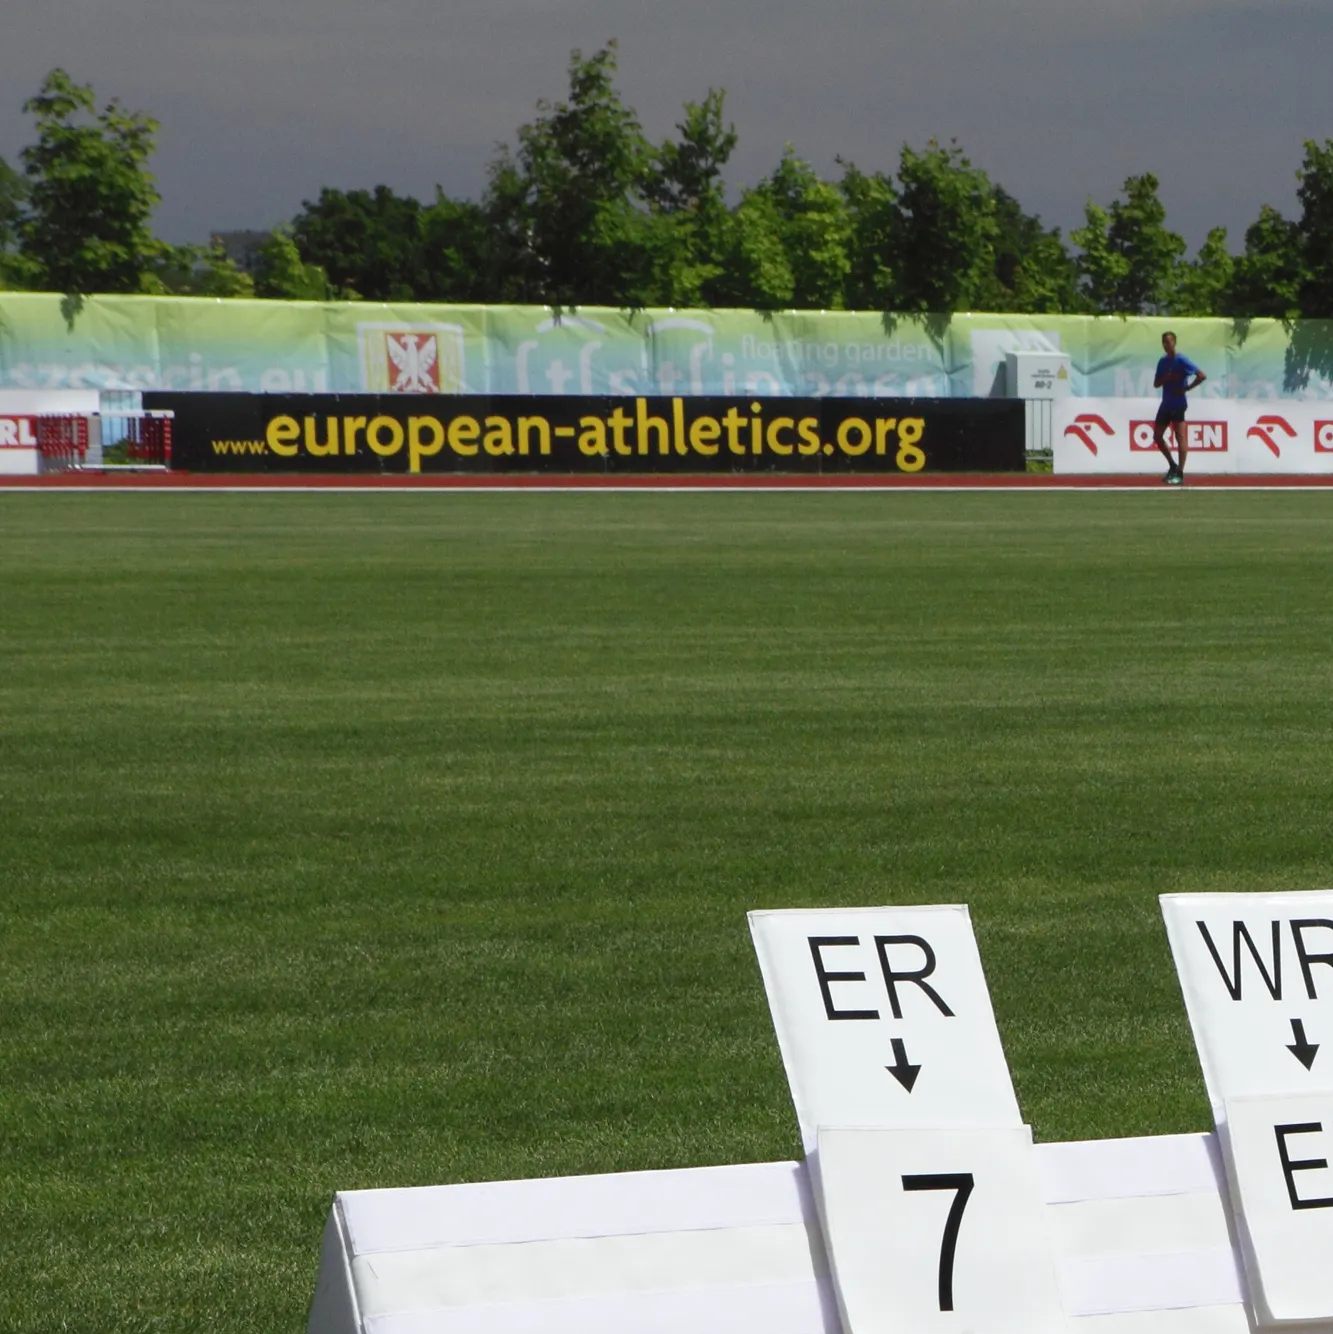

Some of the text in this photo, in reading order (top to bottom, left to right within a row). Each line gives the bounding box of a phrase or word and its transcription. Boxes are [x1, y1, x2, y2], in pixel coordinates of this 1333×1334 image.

[845, 339, 933, 368] garden
[211, 397, 926, 473] www.european-athletics.org
[807, 934, 956, 1021] ER
[900, 1172, 975, 1312] 7
